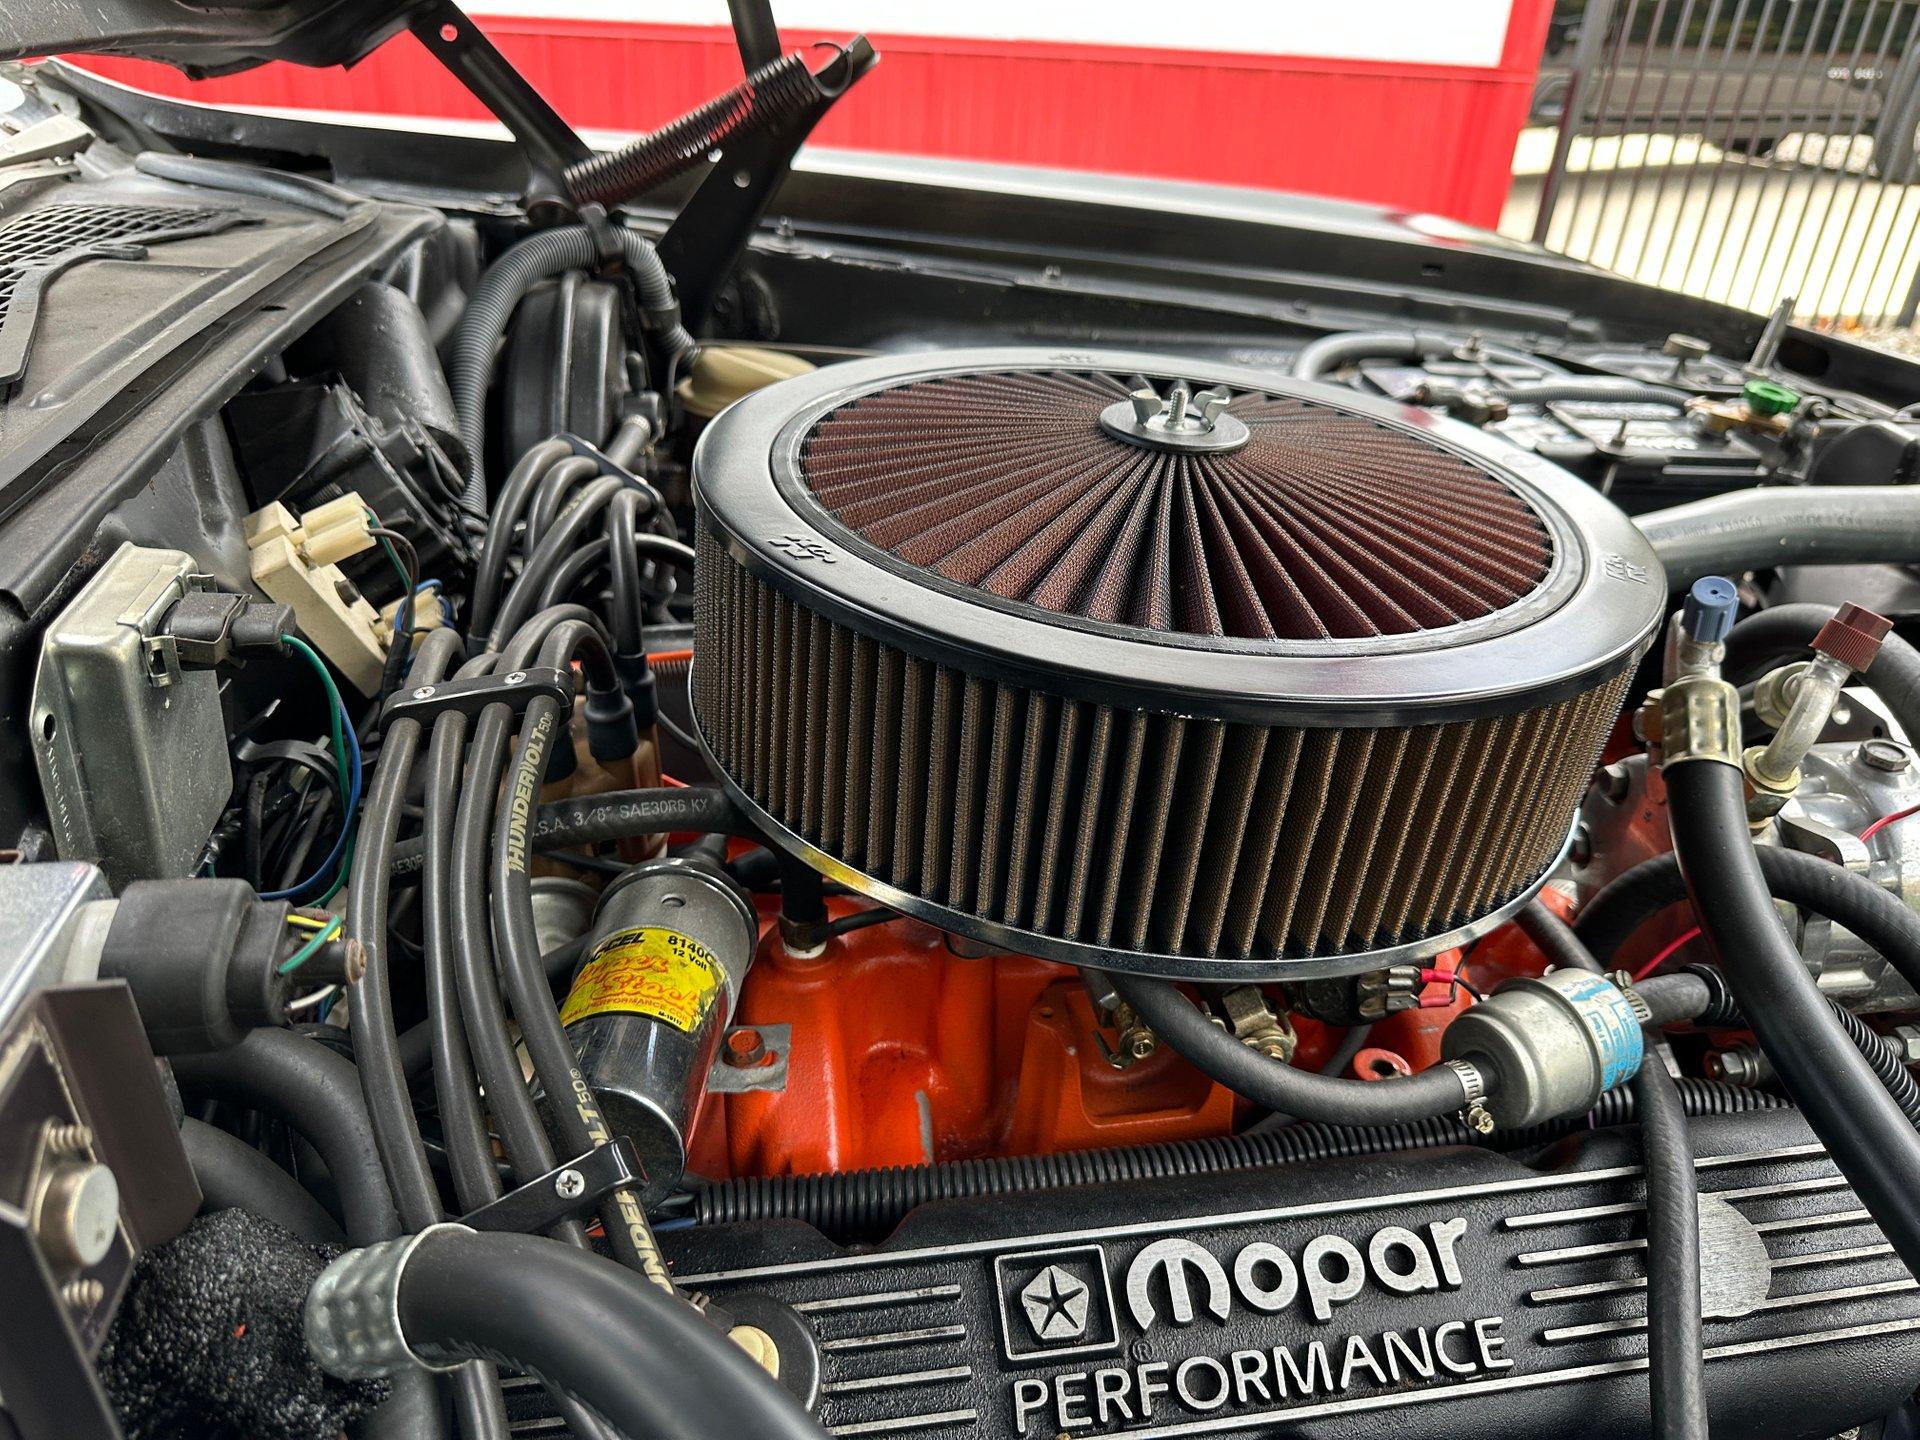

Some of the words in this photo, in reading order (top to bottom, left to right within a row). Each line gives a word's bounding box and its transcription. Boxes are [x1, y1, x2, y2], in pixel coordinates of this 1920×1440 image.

[672, 947, 685, 958] 12
[688, 953, 707, 972] Volt
[1013, 1316, 1515, 1434] PERFORMANCE
